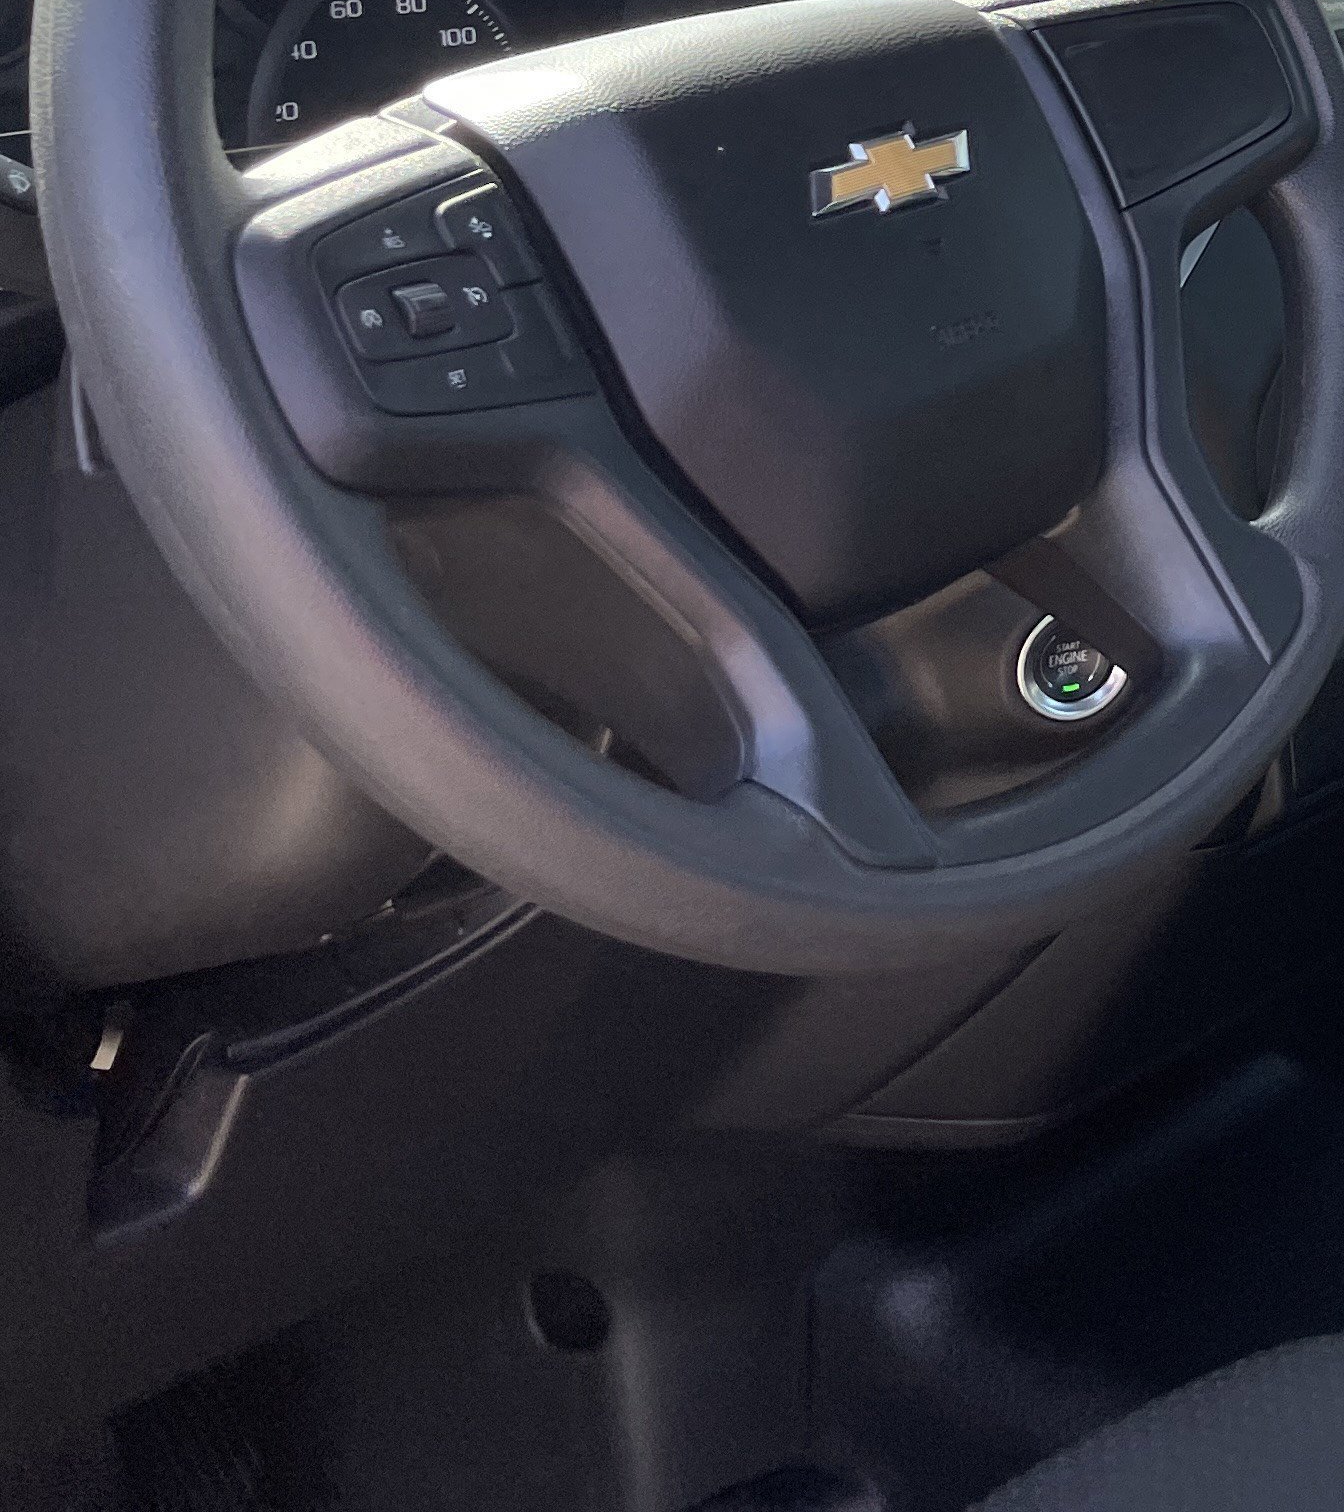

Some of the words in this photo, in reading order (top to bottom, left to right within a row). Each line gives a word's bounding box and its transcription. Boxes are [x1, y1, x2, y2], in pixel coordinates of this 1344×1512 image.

[438, 26, 477, 47] 100
[1056, 640, 1081, 653] START
[1048, 649, 1089, 668] ENGINE
[1057, 664, 1080, 677] STOP
